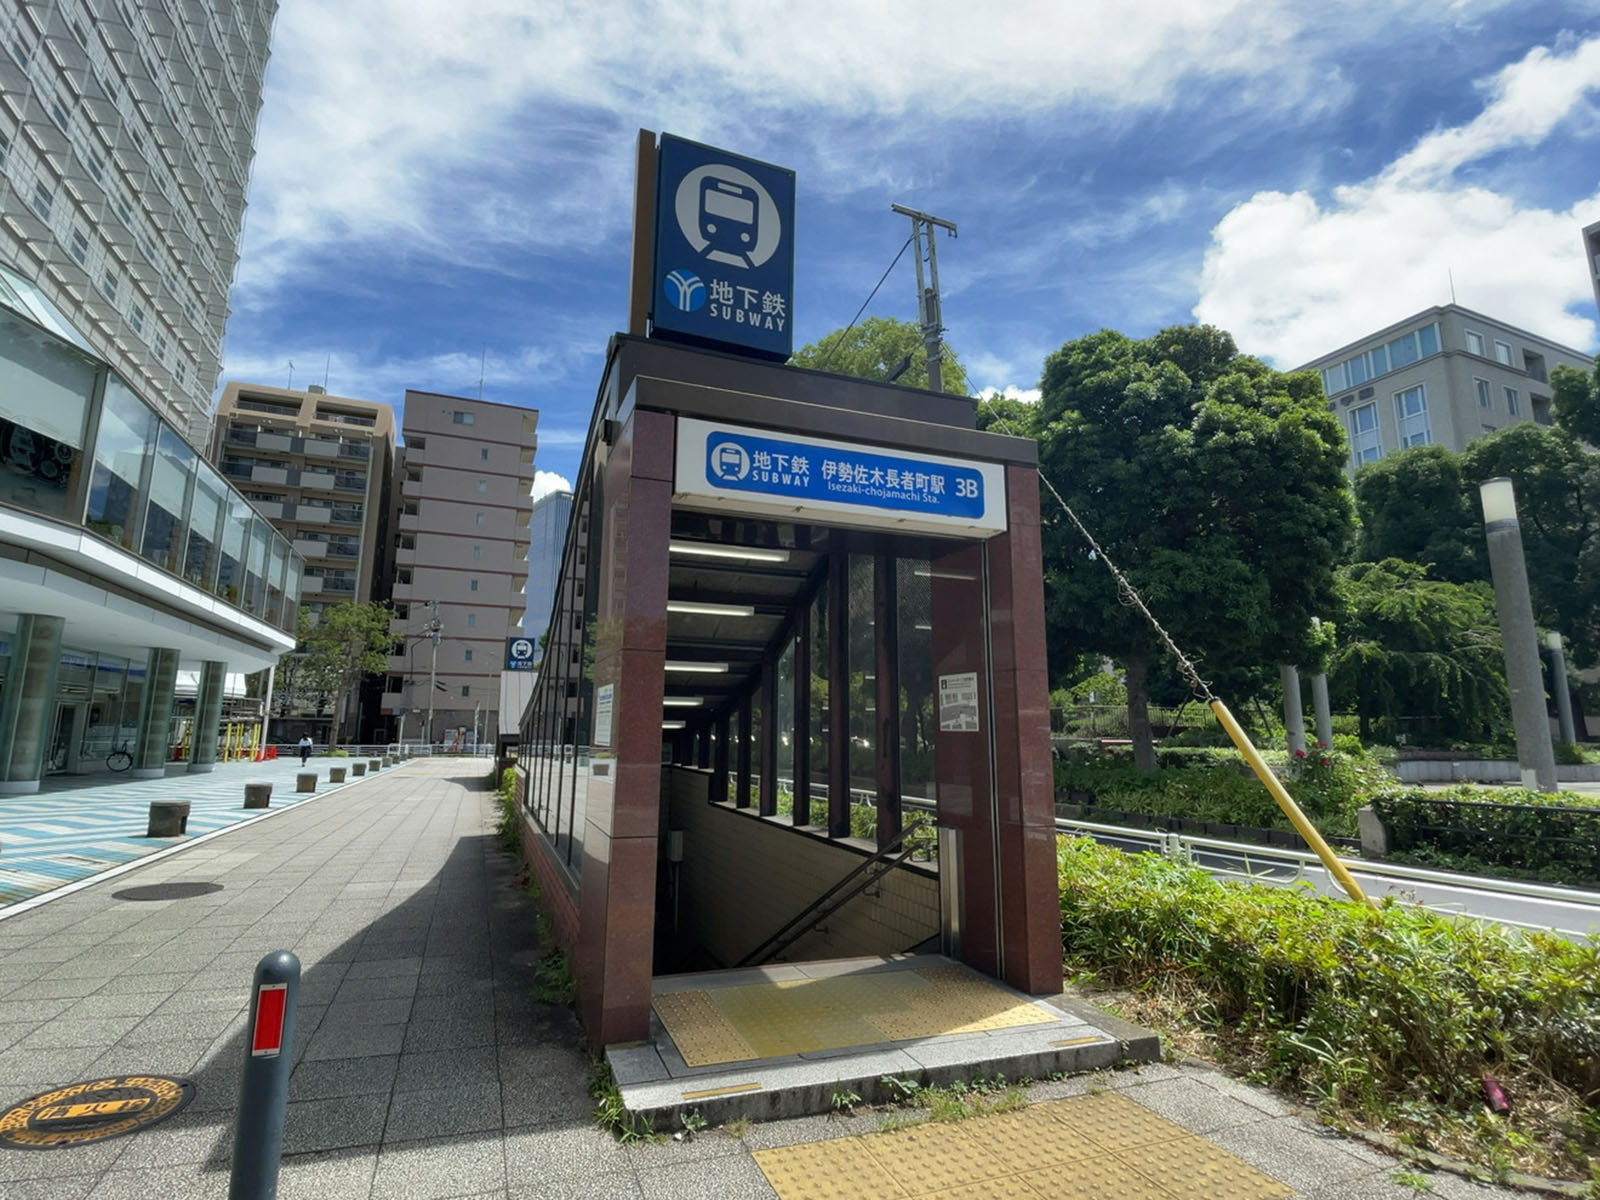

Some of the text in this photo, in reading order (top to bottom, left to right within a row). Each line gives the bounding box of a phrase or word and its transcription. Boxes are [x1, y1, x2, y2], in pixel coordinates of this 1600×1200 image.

[709, 278, 786, 317] 地下鉄
[709, 303, 785, 332] SUBWAY
[752, 450, 810, 476] 地下鉄
[752, 470, 810, 488] SUBWAY
[821, 459, 979, 498] 伊勢佐木長者町駅 3B
[827, 481, 941, 505] Isezaki-chojamachi Sta.
